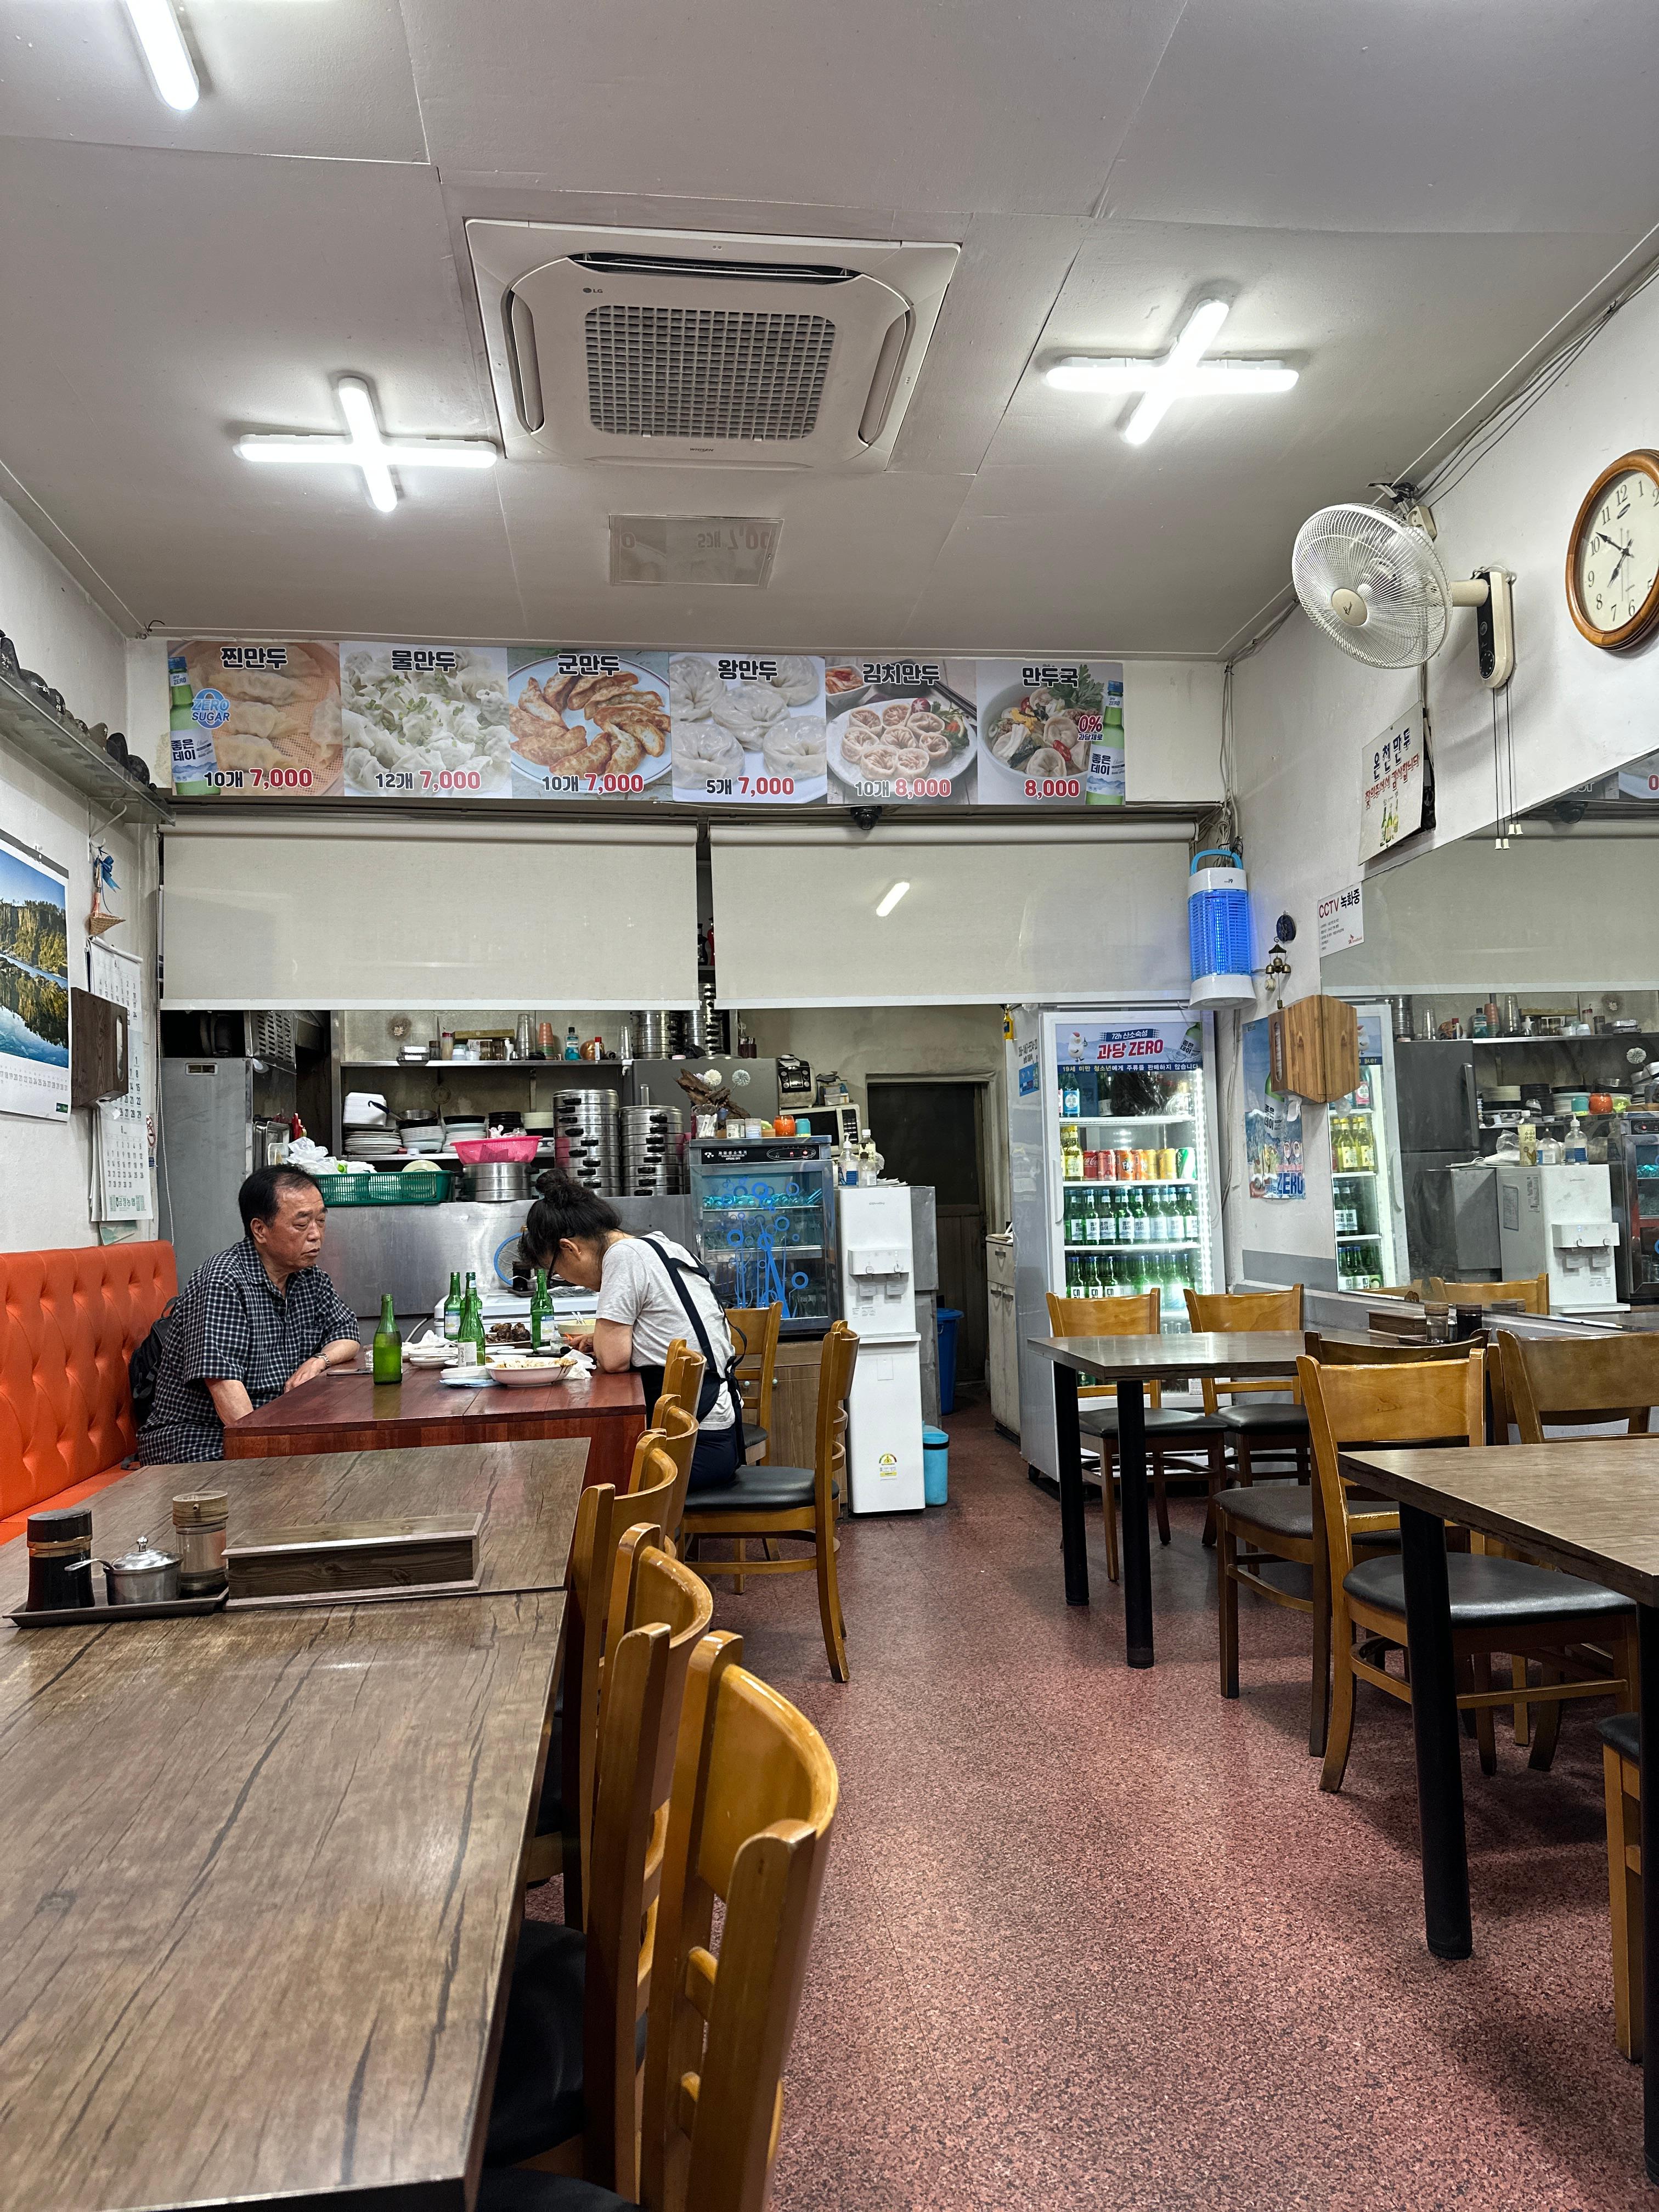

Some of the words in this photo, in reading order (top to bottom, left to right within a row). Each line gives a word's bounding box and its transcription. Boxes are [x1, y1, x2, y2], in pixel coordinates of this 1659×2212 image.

[1616, 484, 1628, 506] 12
[1638, 480, 1644, 497] 1
[1601, 506, 1611, 526] 11
[1590, 536, 1600, 557] 10
[1588, 571, 1594, 588] 9
[1596, 593, 1602, 610] 8
[1628, 599, 1635, 617] 6
[1611, 604, 1617, 622] 7
[221, 647, 287, 669] 찐만두
[391, 650, 456, 672] 물만두
[558, 653, 620, 676] 군만두
[718, 658, 778, 682] 왕만두
[862, 663, 940, 686] 김치만두
[1022, 666, 1079, 688] 만두국
[173, 677, 187, 685] ZERO
[192, 698, 230, 712] ZERO
[192, 712, 230, 721] SUGAR
[1079, 715, 1103, 732] 0%
[171, 739, 194, 751] 좋은
[172, 749, 196, 761] 데이
[1092, 753, 1111, 765] 좋은
[204, 770, 244, 788] 10개
[249, 768, 312, 790] 7,000
[1091, 764, 1110, 775] 데이
[1391, 753, 1420, 791] 감사합니다
[375, 772, 413, 790] 12개
[419, 770, 481, 792] 7,000
[542, 776, 579, 792] 10개
[585, 773, 644, 795] 7,000
[706, 778, 732, 795] 5개
[737, 776, 795, 798] 7,000
[854, 780, 889, 798] 10개
[894, 777, 952, 799] 8,000
[1024, 777, 1079, 799] 8,000
[1319, 897, 1339, 918] CCTV
[1340, 888, 1360, 909] 녹화중
[1123, 1030, 1148, 1039] 산소숙성
[1097, 1043, 1127, 1060] 과당
[1128, 1039, 1164, 1057] ZERO
[135, 1056, 138, 1064] 1
[129, 1068, 132, 1077] 7
[136, 1070, 138, 1078] 8
[129, 1082, 133, 1091] 14
[136, 1083, 140, 1092] 15
[1277, 1172, 1304, 1195] ZERO
